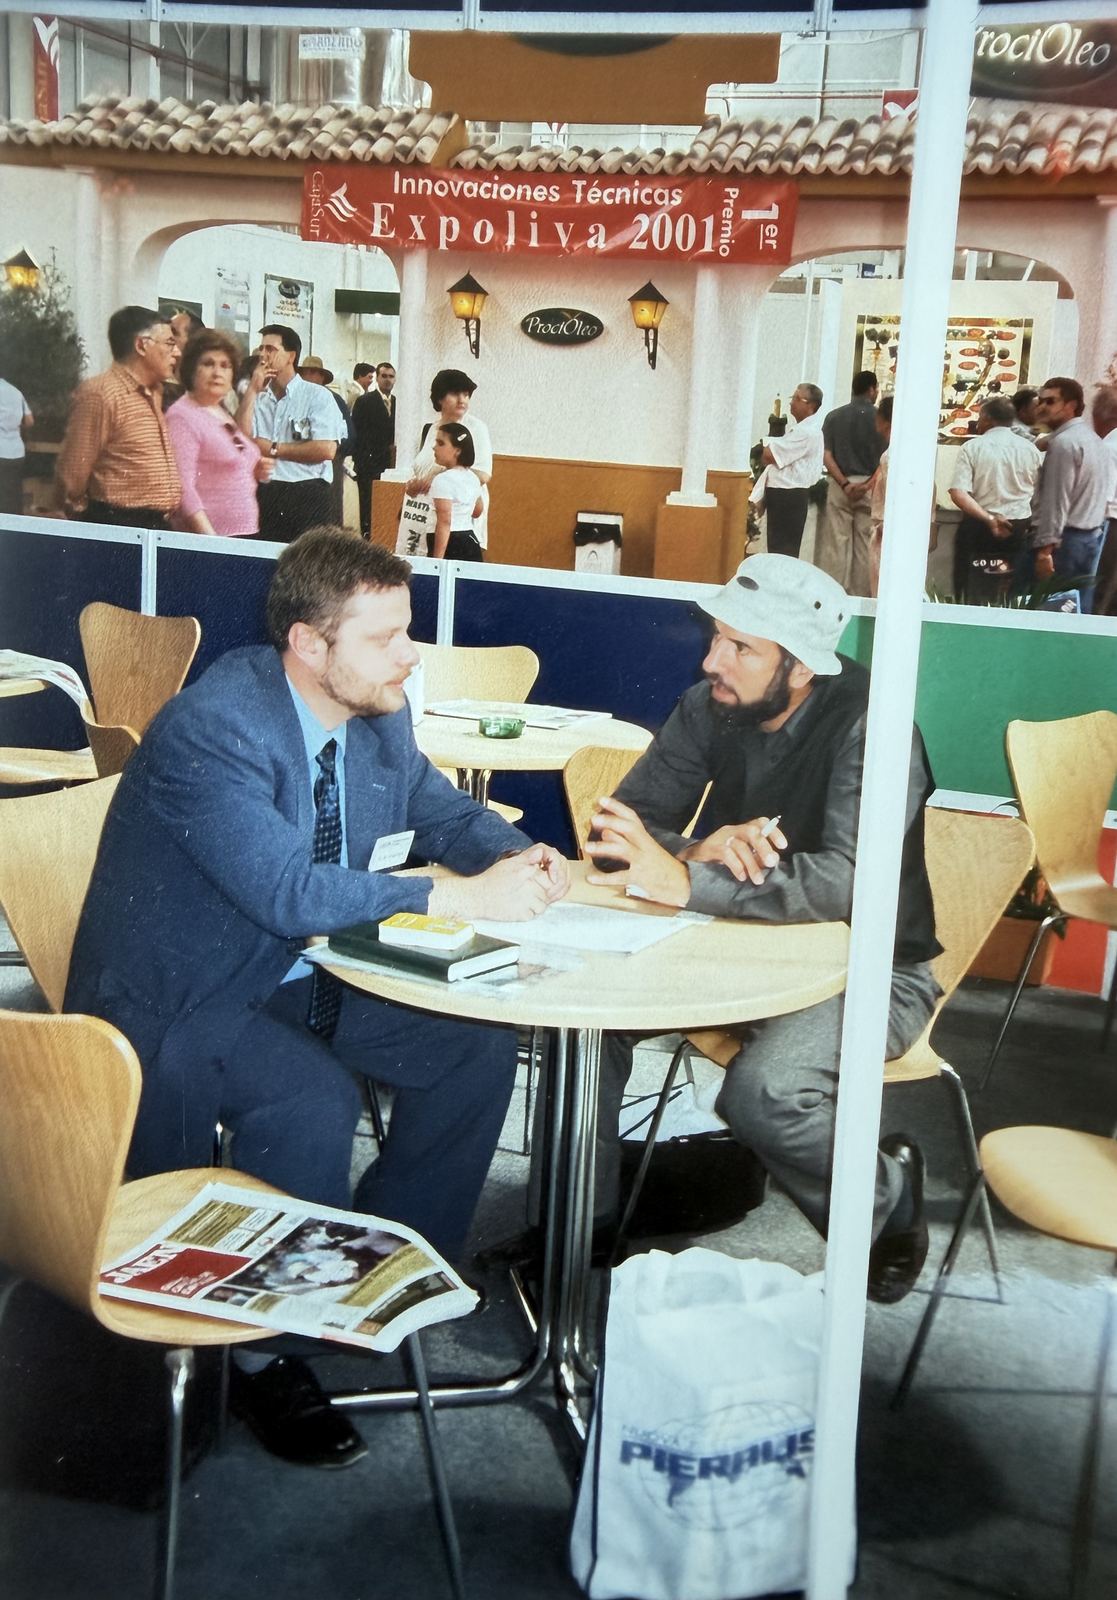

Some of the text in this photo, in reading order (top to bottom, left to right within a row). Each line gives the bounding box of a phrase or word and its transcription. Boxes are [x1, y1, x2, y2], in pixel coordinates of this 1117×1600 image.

[309, 170, 325, 237] CajaSur
[393, 170, 684, 206] Innovaciones Técnicas
[370, 202, 716, 252] Expoliva 2001
[718, 187, 740, 258] Premio
[740, 203, 779, 250] 1er
[525, 316, 598, 336] ProciOleo
